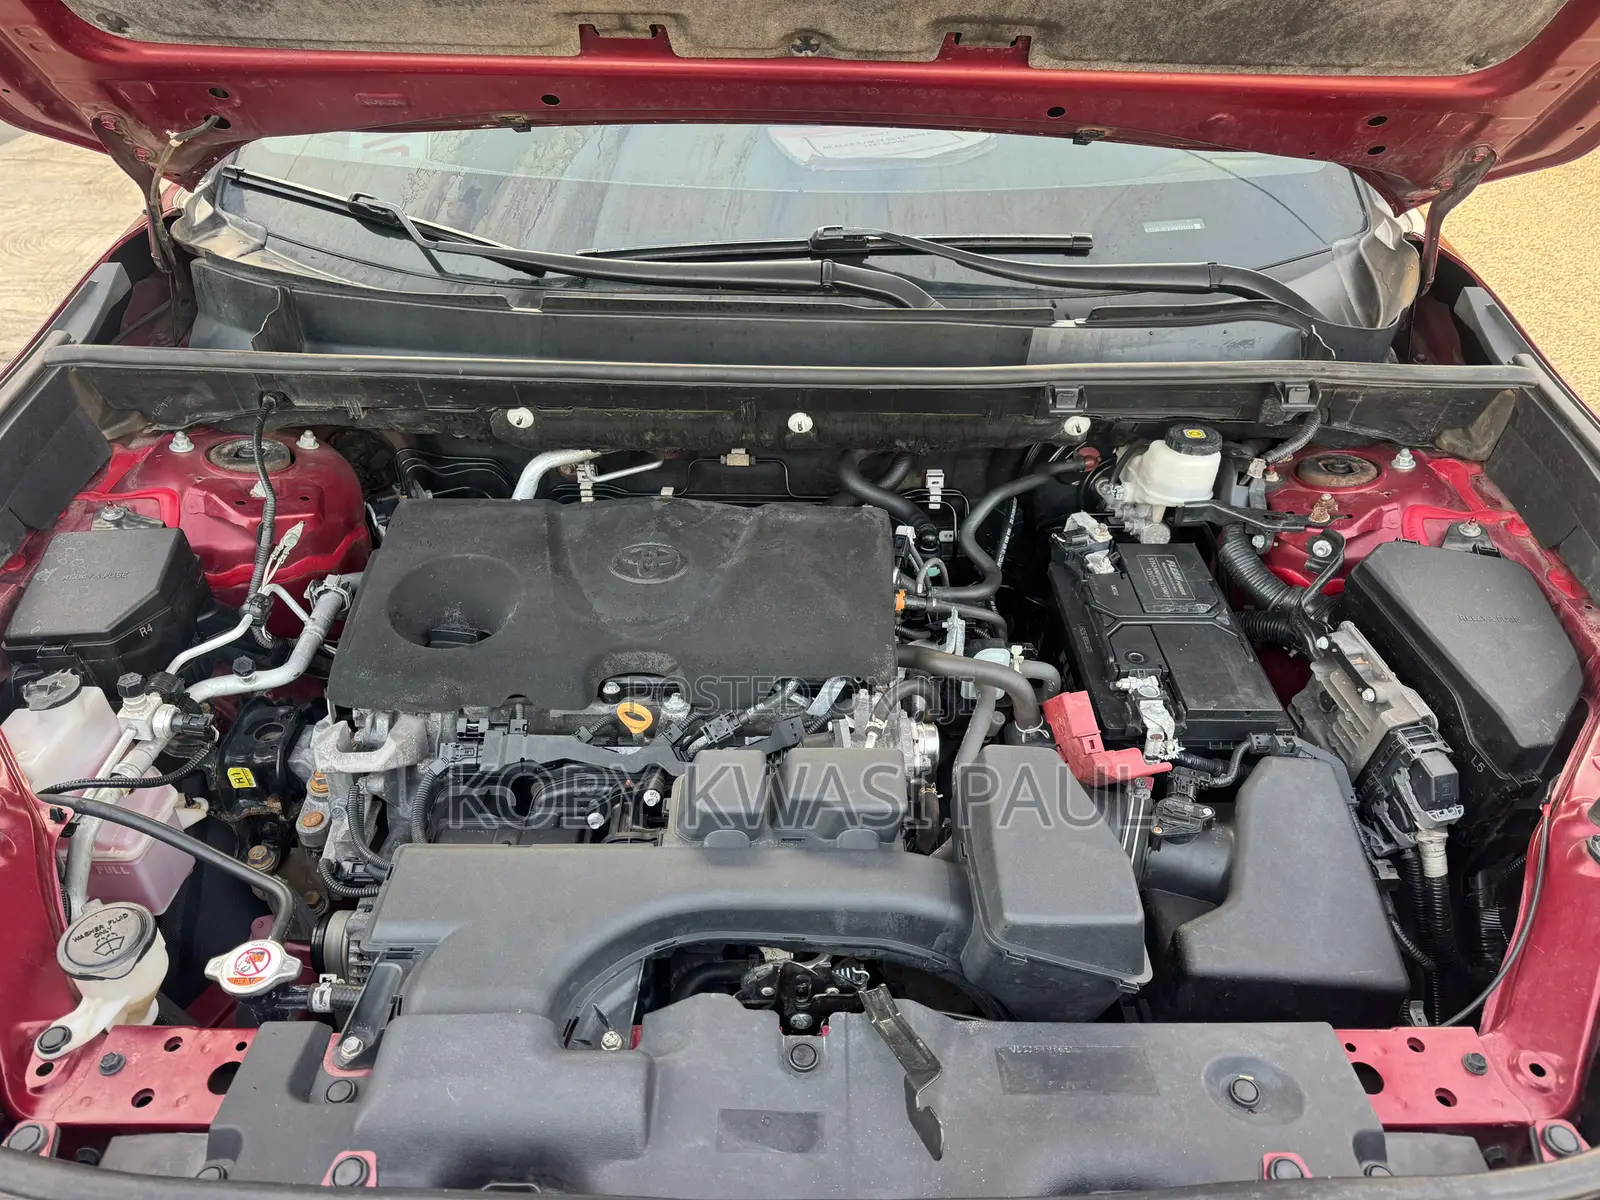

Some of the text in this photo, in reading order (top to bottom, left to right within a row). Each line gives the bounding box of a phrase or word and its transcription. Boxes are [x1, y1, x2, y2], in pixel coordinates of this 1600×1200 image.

[139, 623, 153, 637] R4
[1470, 754, 1486, 773] L5
[96, 866, 130, 875] FULL
[72, 912, 129, 942] WASHER FLUID
[93, 925, 113, 939] ONLY
